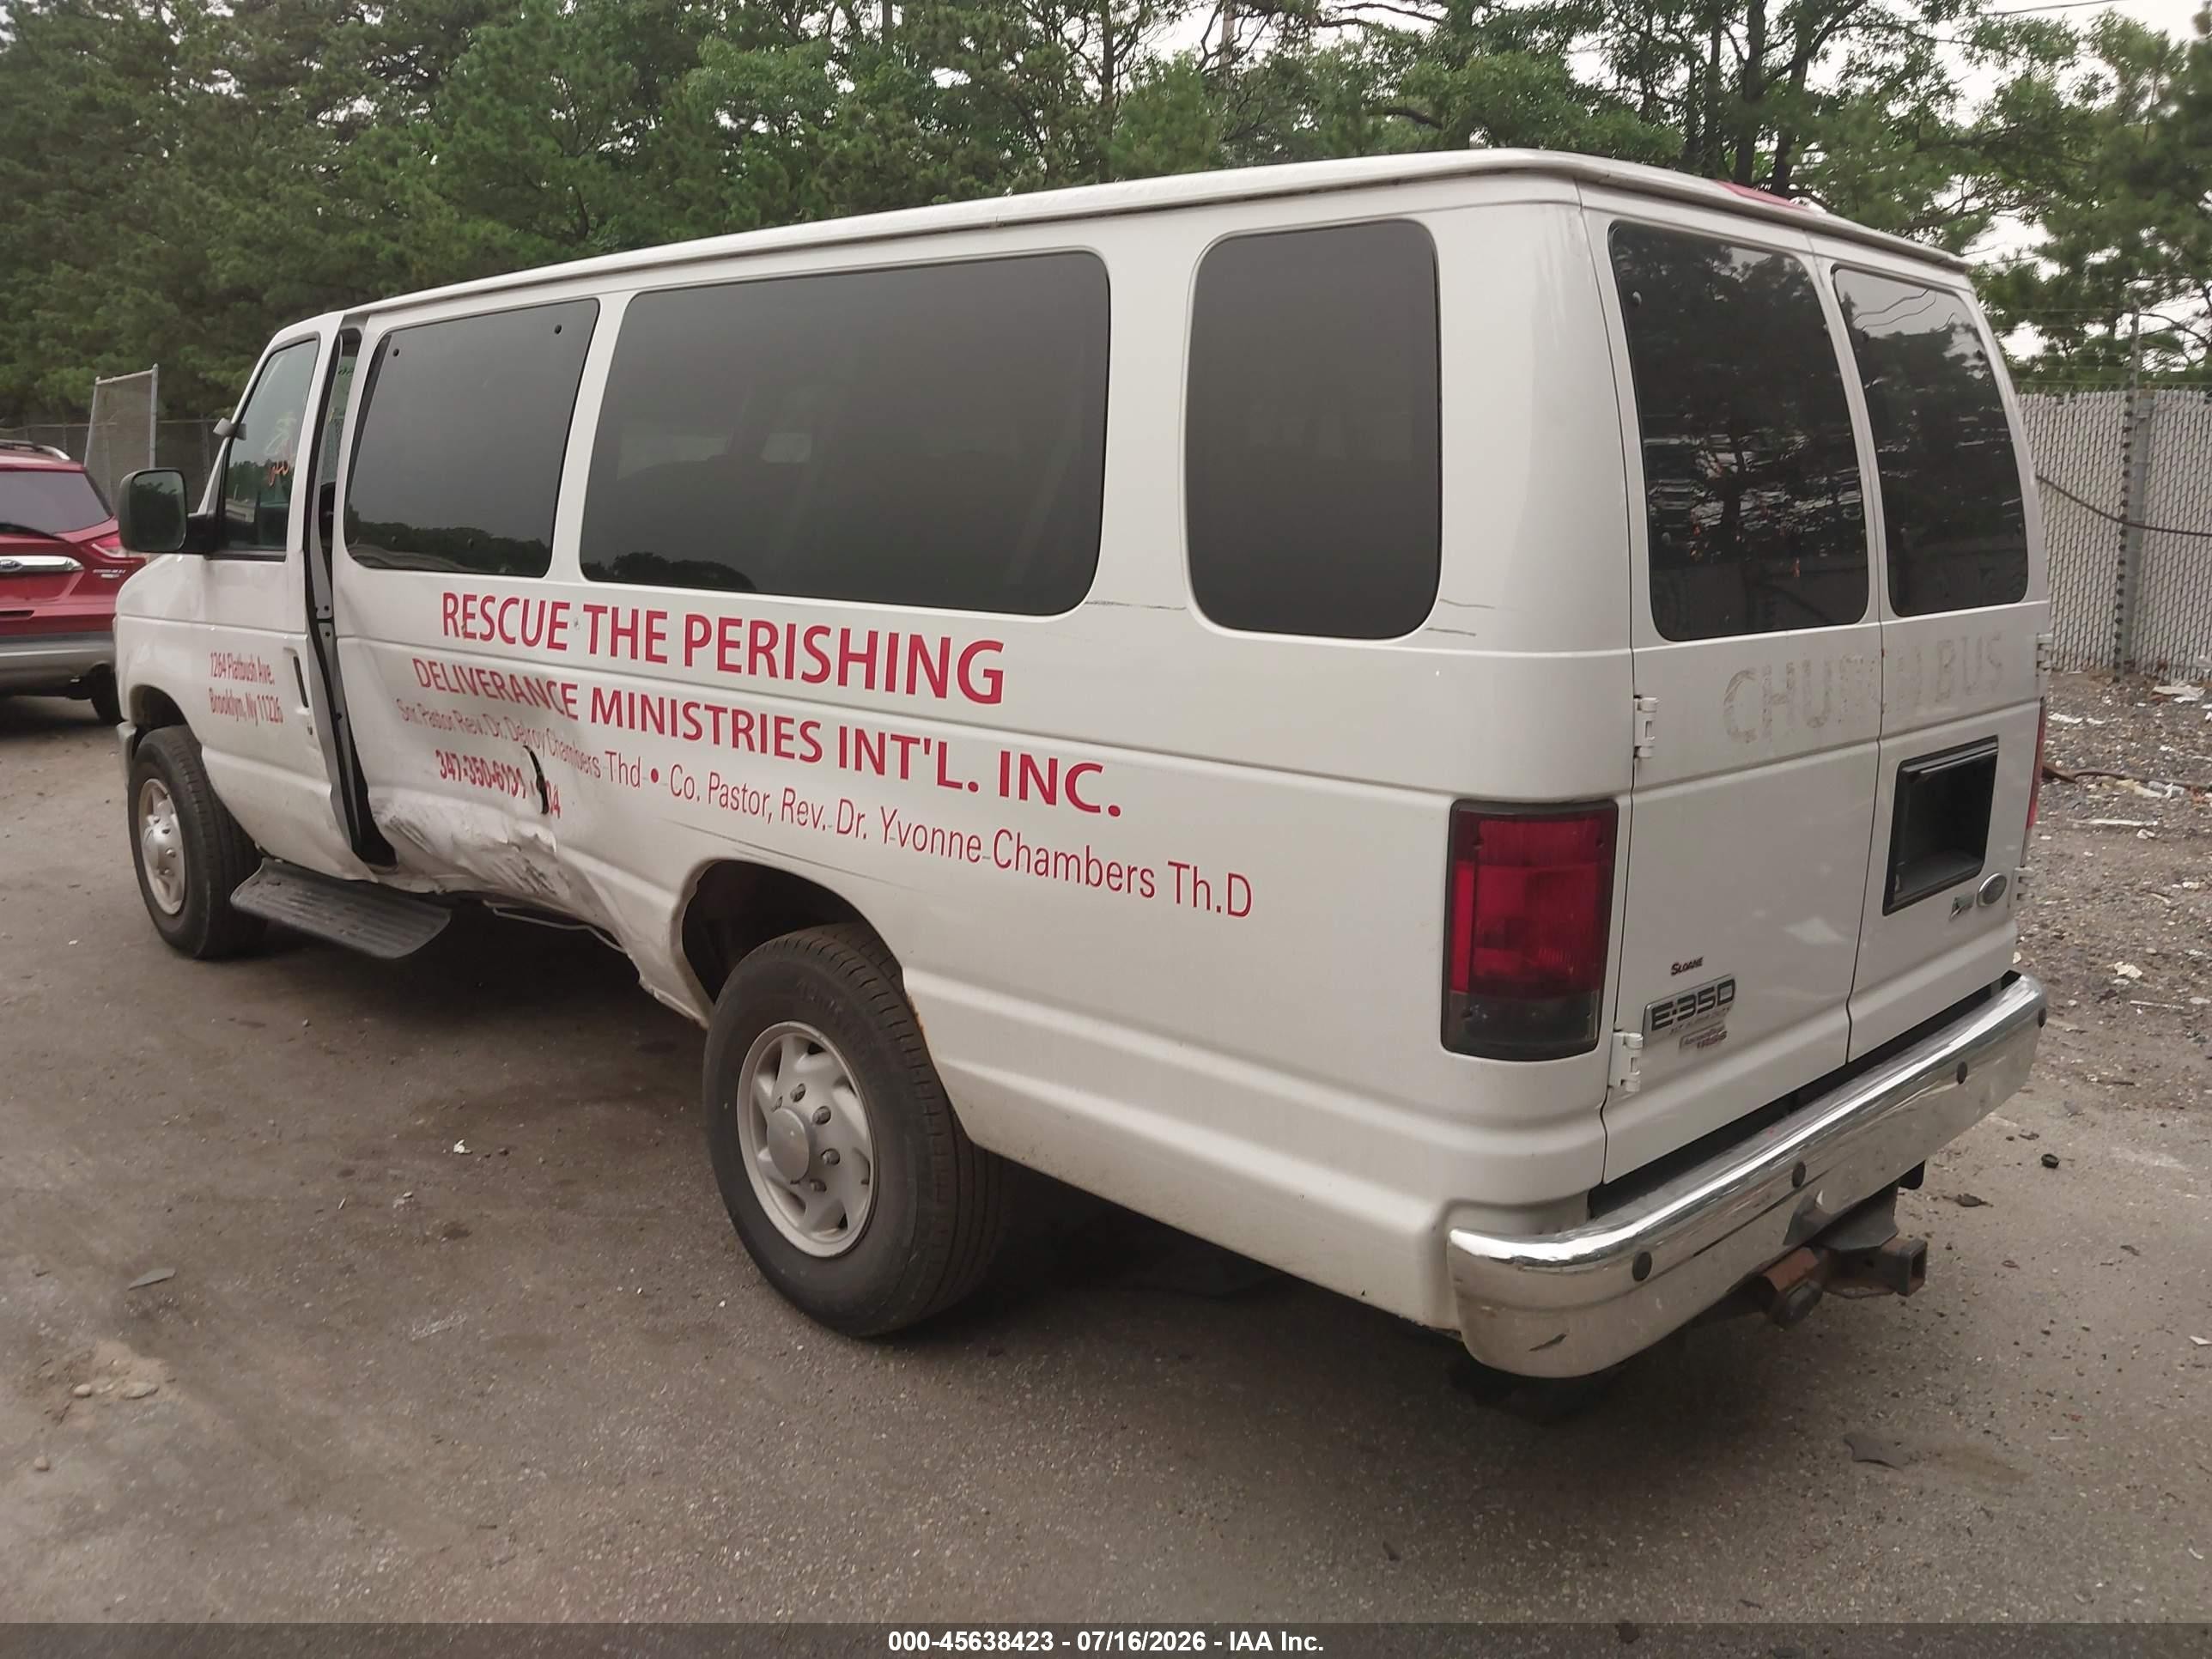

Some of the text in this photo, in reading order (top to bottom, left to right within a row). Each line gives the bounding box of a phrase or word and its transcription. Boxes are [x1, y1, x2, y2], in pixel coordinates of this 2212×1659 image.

[227, 652, 257, 683] Flatbush
[442, 592, 1005, 704] RESCUE THE PERISHING
[1934, 631, 2004, 705] BUS
[257, 694, 283, 723] 11226
[412, 658, 1121, 817] DELIVERANCE MINISTRIES INT'L. INC.
[543, 727, 601, 779] Chambers
[605, 750, 641, 789] Thd
[670, 763, 701, 802] Co.
[708, 771, 774, 824] Pastor,
[781, 787, 826, 831] Rev.
[836, 798, 867, 840] Dr.
[879, 805, 982, 863] Yvonne
[993, 828, 1156, 899] Chambers
[1168, 860, 1254, 918] Th.D
